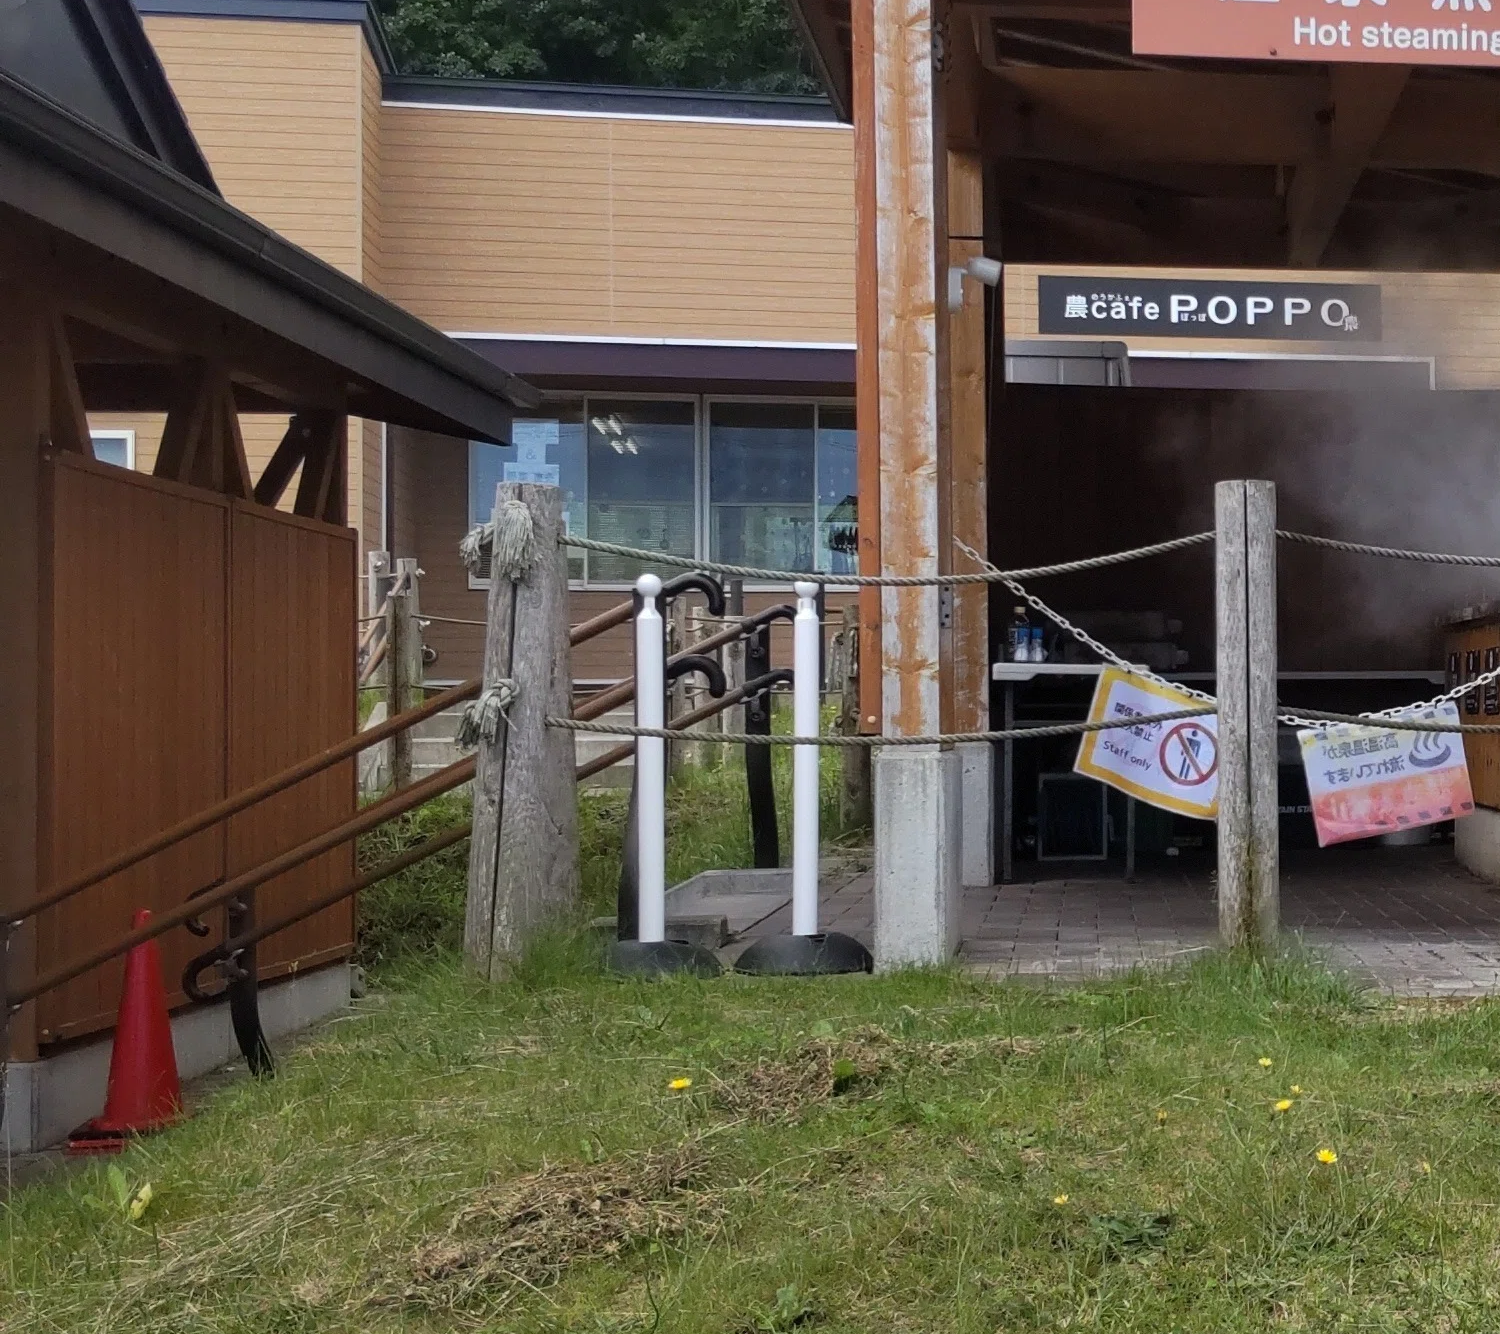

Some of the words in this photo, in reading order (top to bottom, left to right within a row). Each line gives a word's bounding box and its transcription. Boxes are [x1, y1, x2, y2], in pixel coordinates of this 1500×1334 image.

[1293, 17, 1352, 47] Hot
[1170, 294, 1350, 327] POPPO
[1103, 741, 1129, 759] Staff
[1131, 756, 1152, 771] only
